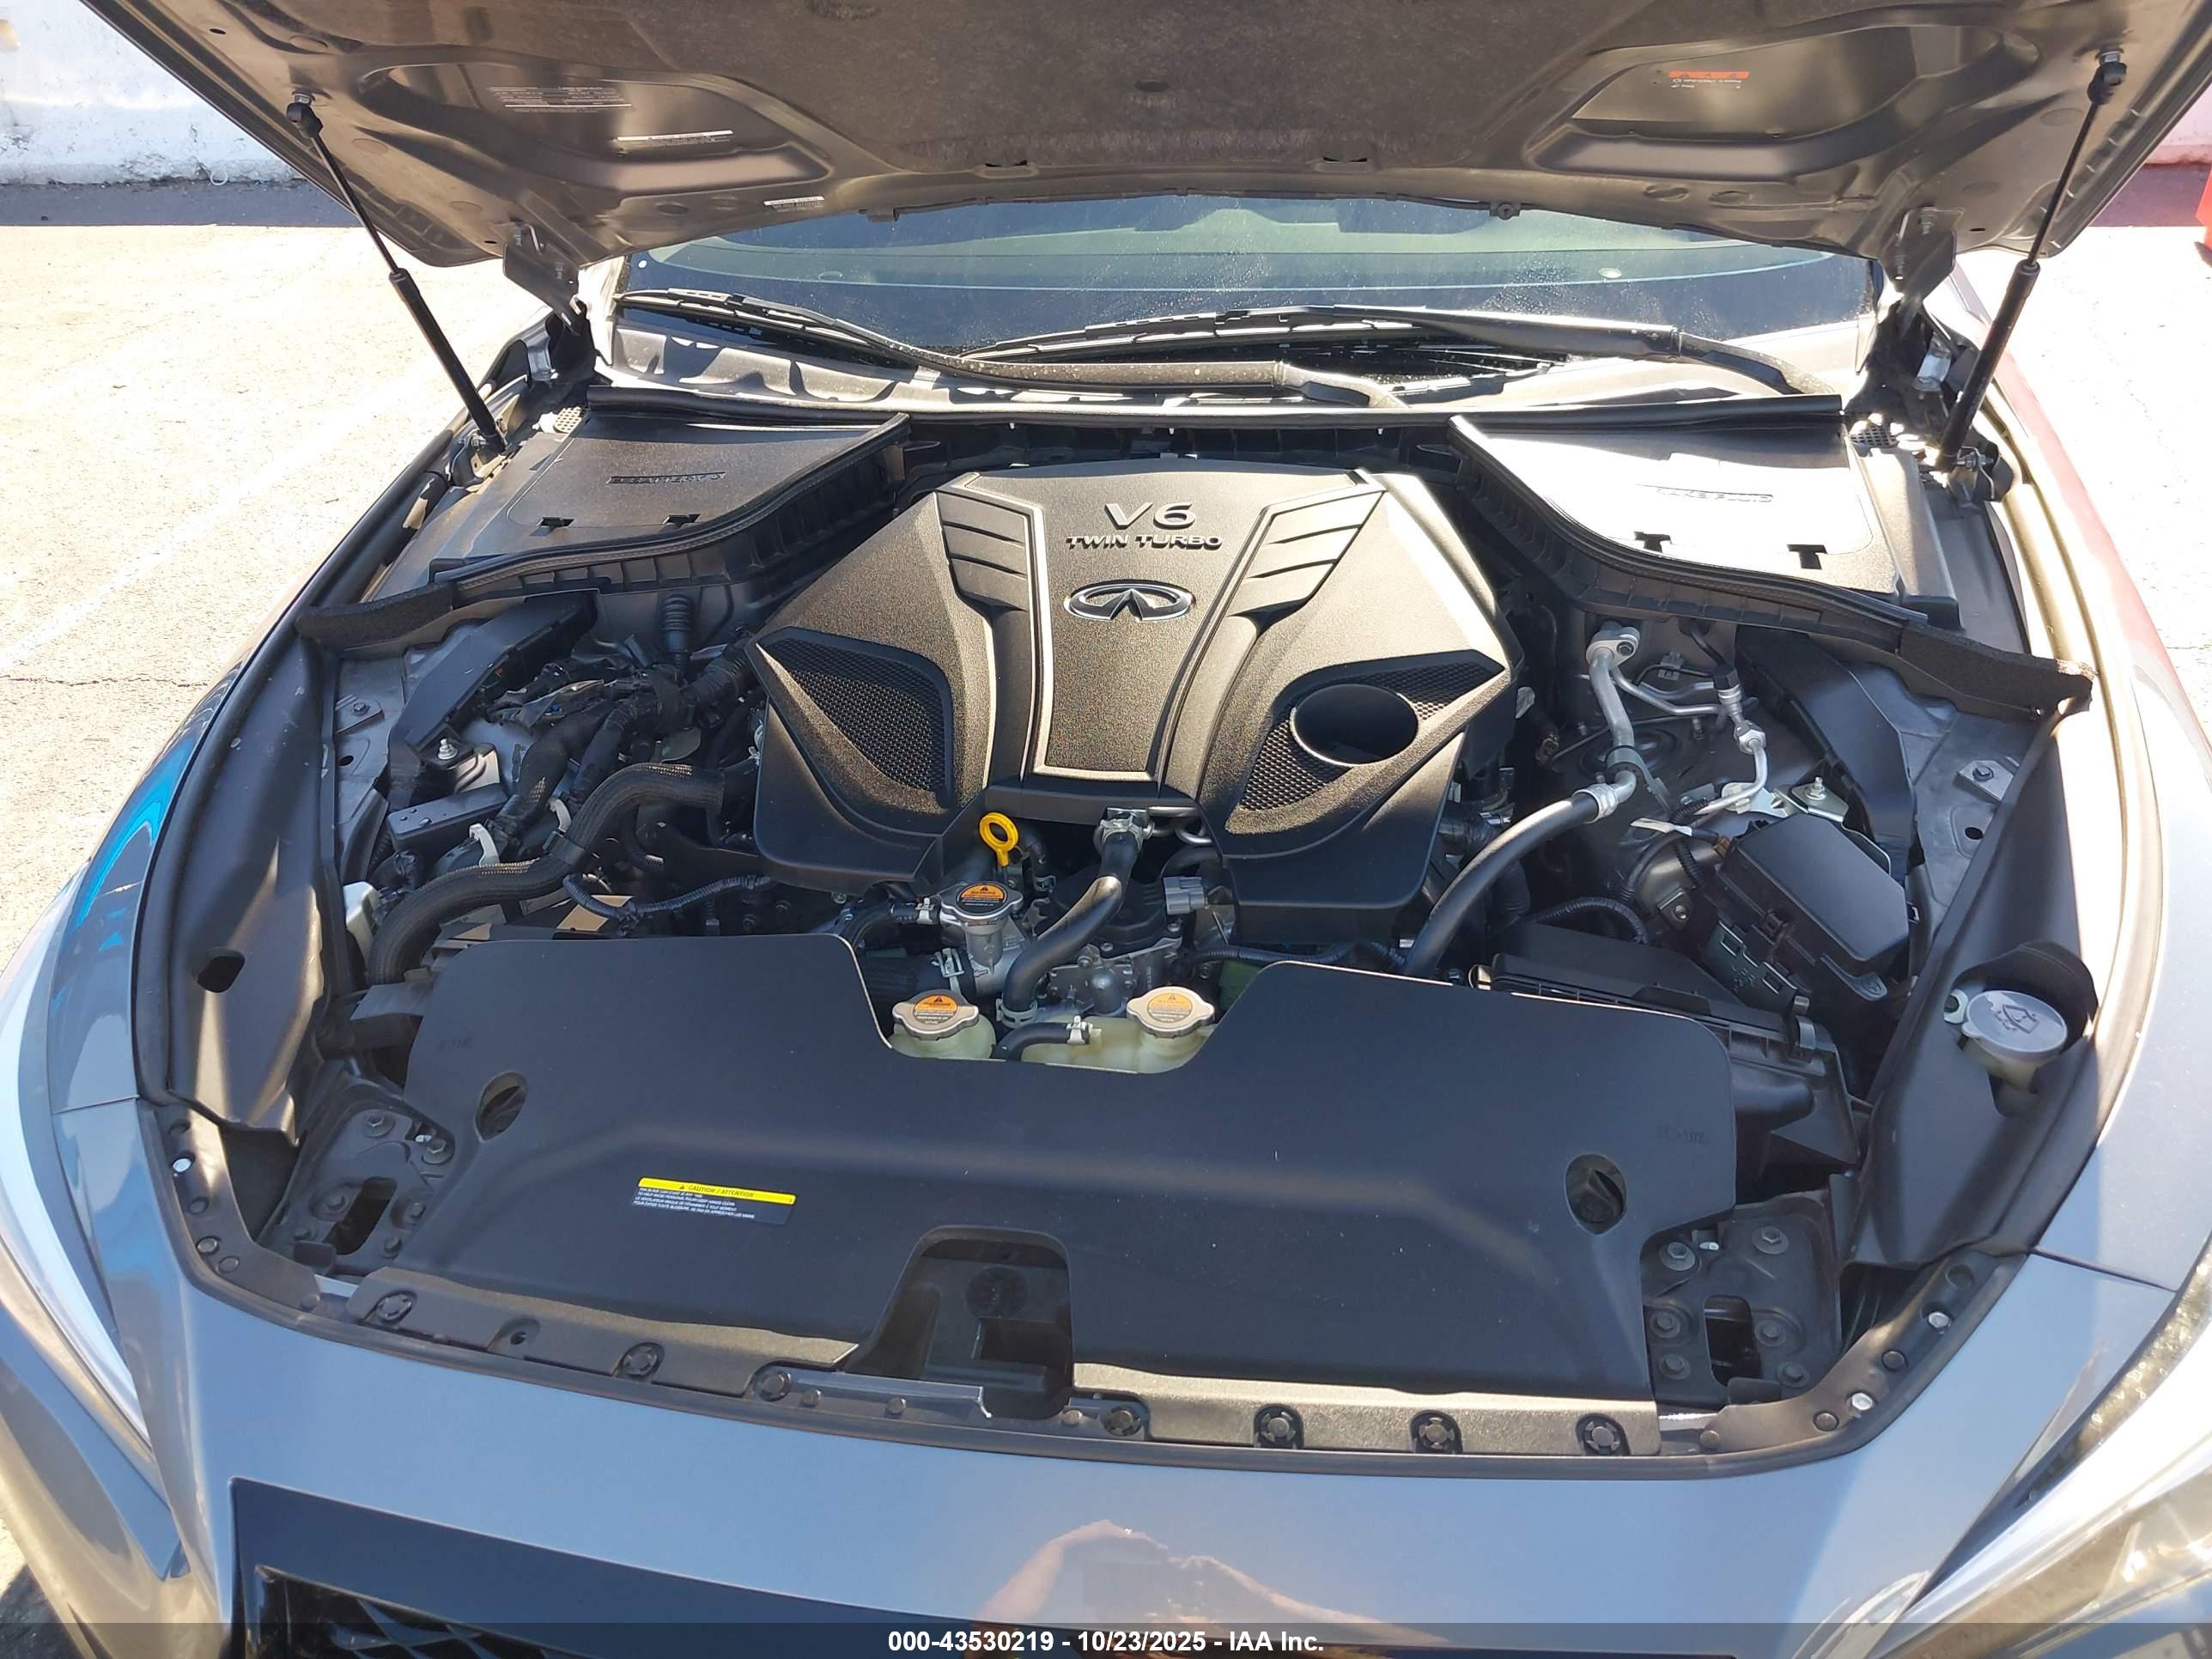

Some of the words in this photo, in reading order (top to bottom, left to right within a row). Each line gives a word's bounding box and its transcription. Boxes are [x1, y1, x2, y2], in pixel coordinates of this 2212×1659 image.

[1104, 501, 1196, 530] V6
[1066, 534, 1129, 550] TWIN
[1134, 534, 1223, 550] TURBO
[688, 1185, 715, 1194] CAUTION
[720, 1188, 755, 1198] ATTENTION
